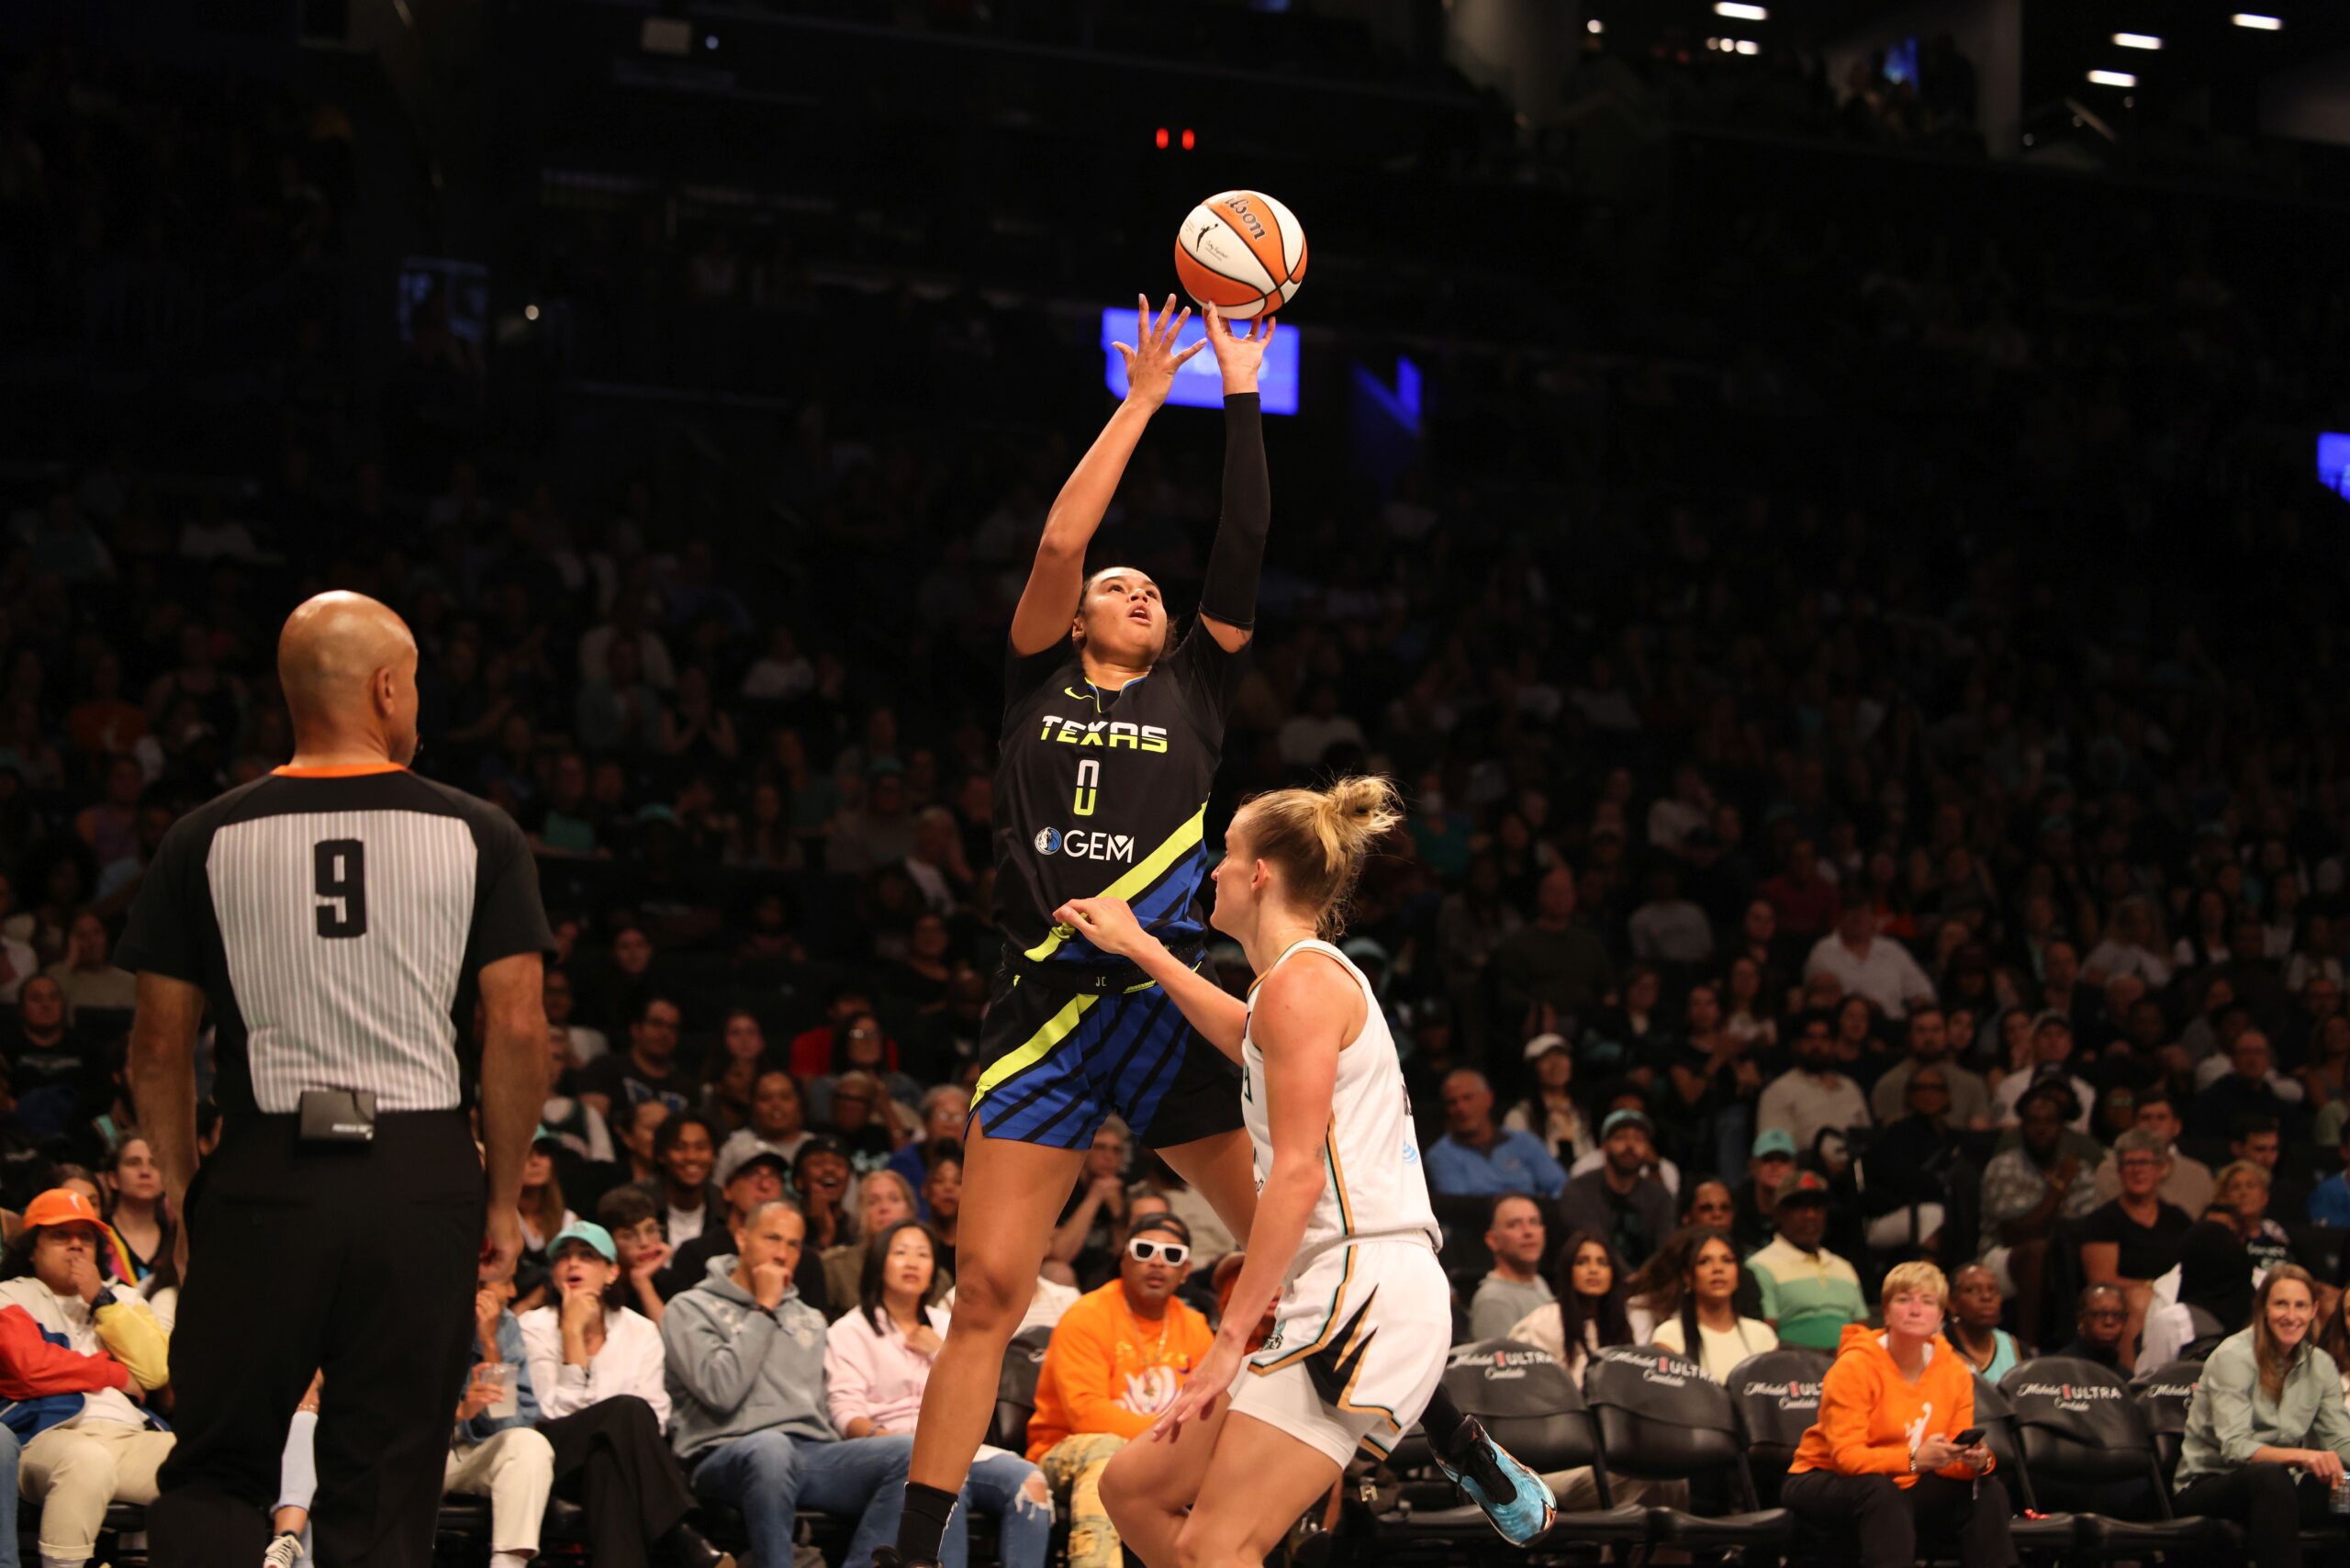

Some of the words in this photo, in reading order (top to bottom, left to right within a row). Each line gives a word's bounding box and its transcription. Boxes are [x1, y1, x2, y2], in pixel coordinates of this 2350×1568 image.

[1225, 197, 1266, 241] ilson
[1040, 715, 1168, 754] TEXAS
[1073, 759, 1100, 816] 0
[1063, 829, 1135, 863] GEM
[314, 838, 367, 939] 9
[2071, 1386, 2122, 1399] ULTRA
